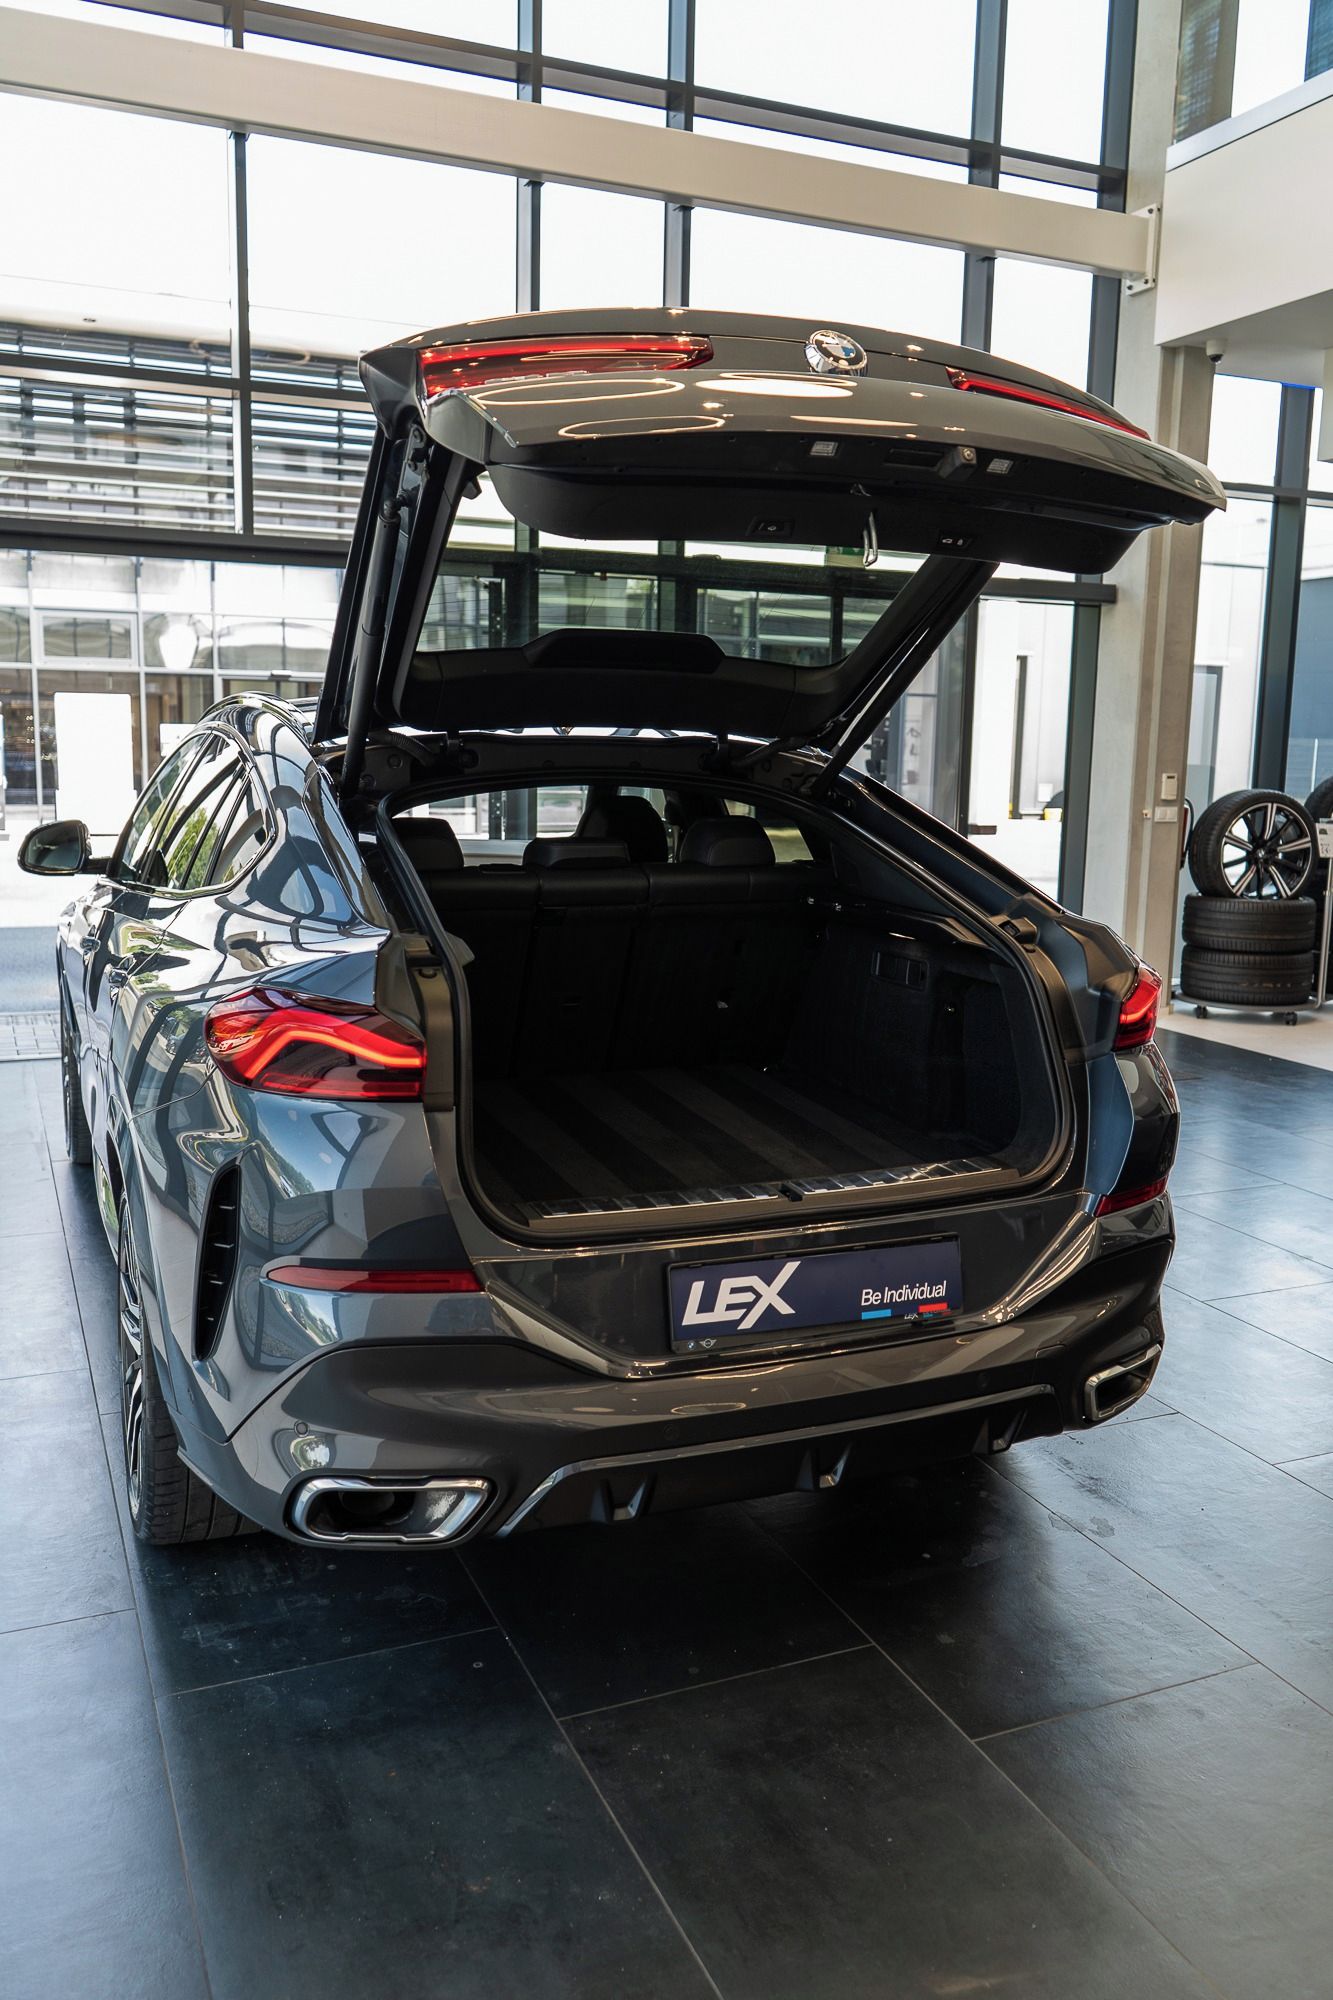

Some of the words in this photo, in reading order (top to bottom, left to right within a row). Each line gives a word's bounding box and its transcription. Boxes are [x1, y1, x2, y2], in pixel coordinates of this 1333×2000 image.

[681, 1260, 801, 1330] LEX
[861, 1289, 881, 1306] Be
[883, 1280, 947, 1304] Individual
